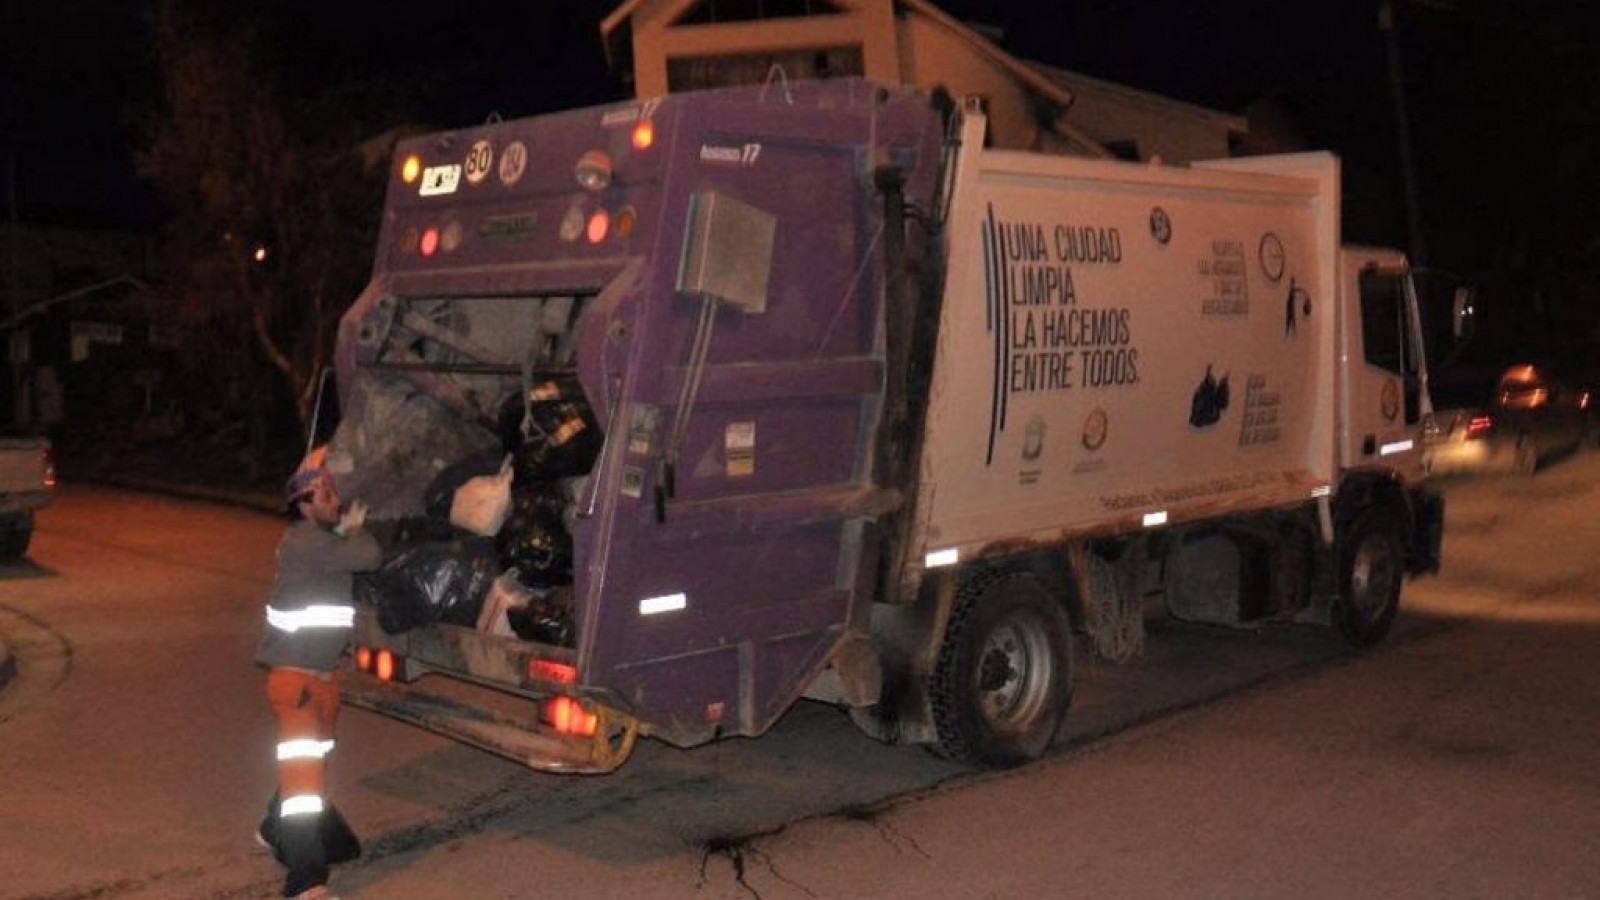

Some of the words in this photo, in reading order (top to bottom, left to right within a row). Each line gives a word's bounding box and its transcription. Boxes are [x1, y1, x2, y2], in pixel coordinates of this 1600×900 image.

[466, 146, 490, 174] 80
[742, 144, 761, 165] 17
[1006, 223, 1048, 261] UNA
[1054, 224, 1122, 264] CIUDAD
[1010, 265, 1076, 305] LIMPIA
[1013, 310, 1037, 349] LA
[1043, 308, 1130, 348] HACEMOS
[1010, 351, 1073, 392] ENTRE
[1082, 349, 1141, 388] TODOS.
